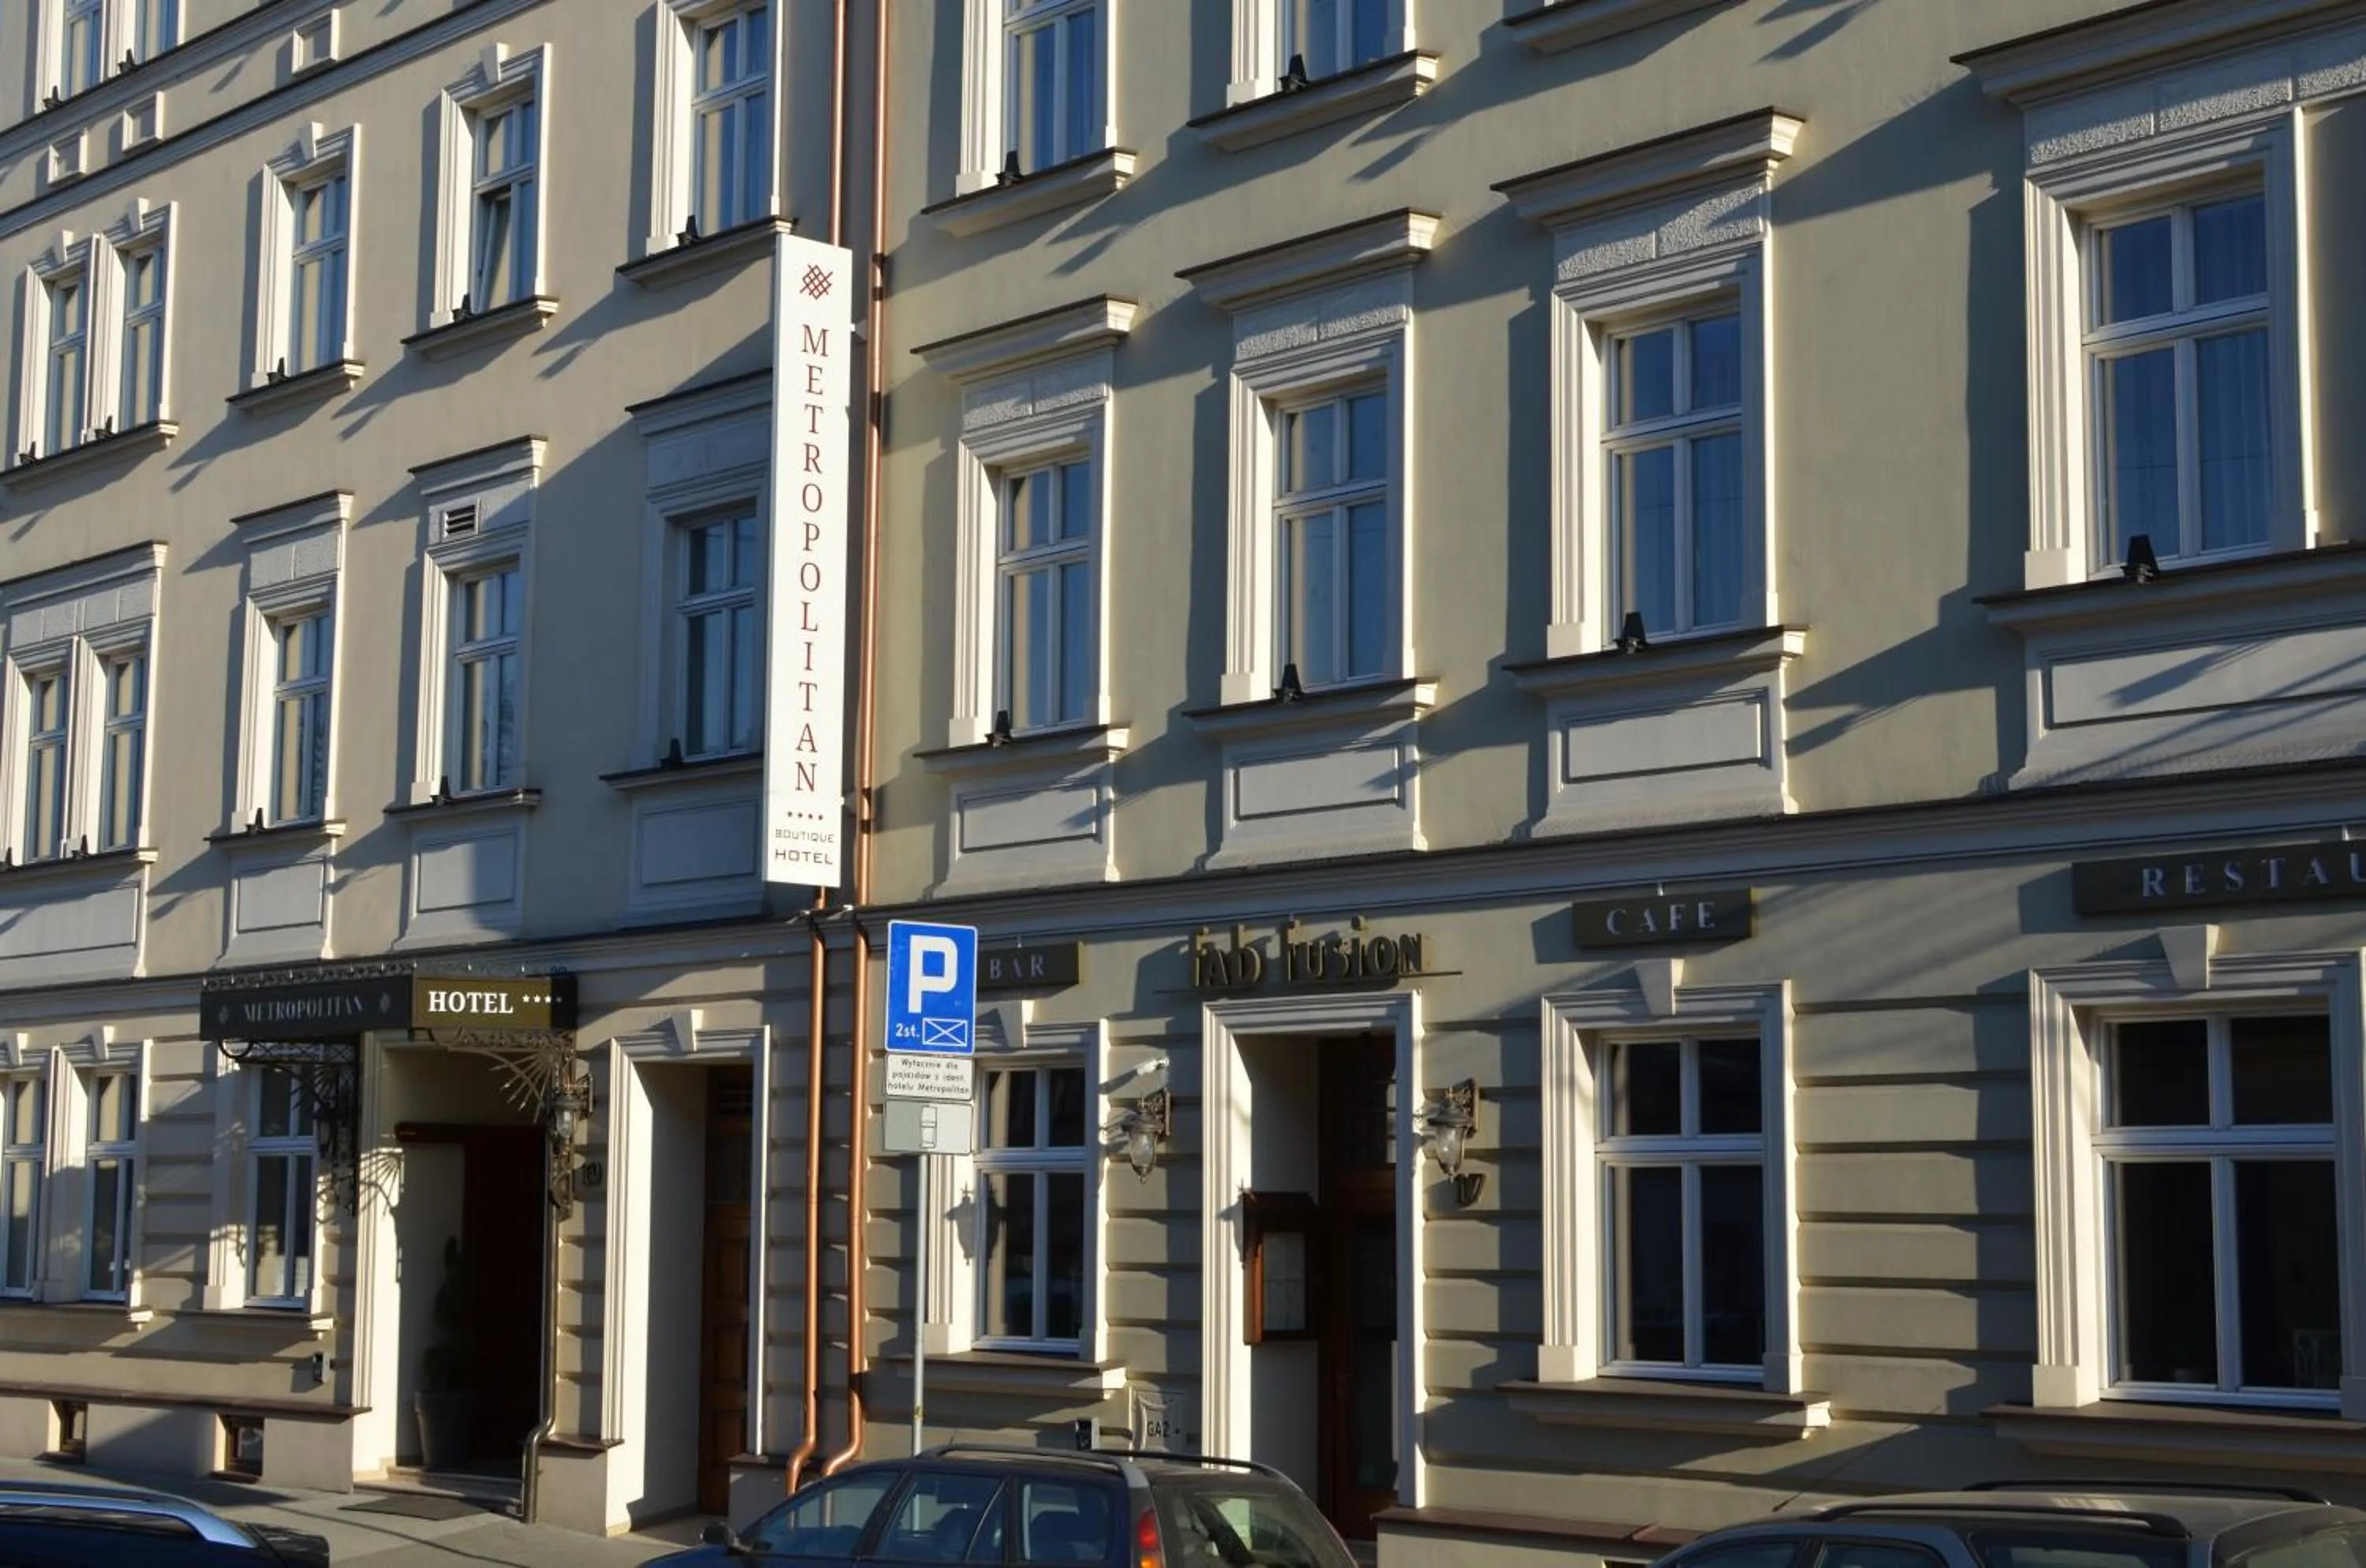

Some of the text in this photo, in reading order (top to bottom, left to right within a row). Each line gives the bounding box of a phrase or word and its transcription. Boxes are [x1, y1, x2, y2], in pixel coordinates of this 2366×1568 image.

[794, 323, 830, 793] METROPOLITAN
[774, 828, 834, 843] BOUTIQUE
[774, 848, 834, 865] HOTEL
[1606, 902, 1715, 935] CAFE
[908, 934, 958, 1014] P
[989, 954, 1045, 980] BAR
[243, 995, 365, 1024] METROPOLITAN
[427, 990, 514, 1015] HOTEL
[1148, 1421, 1170, 1438] GAZ
